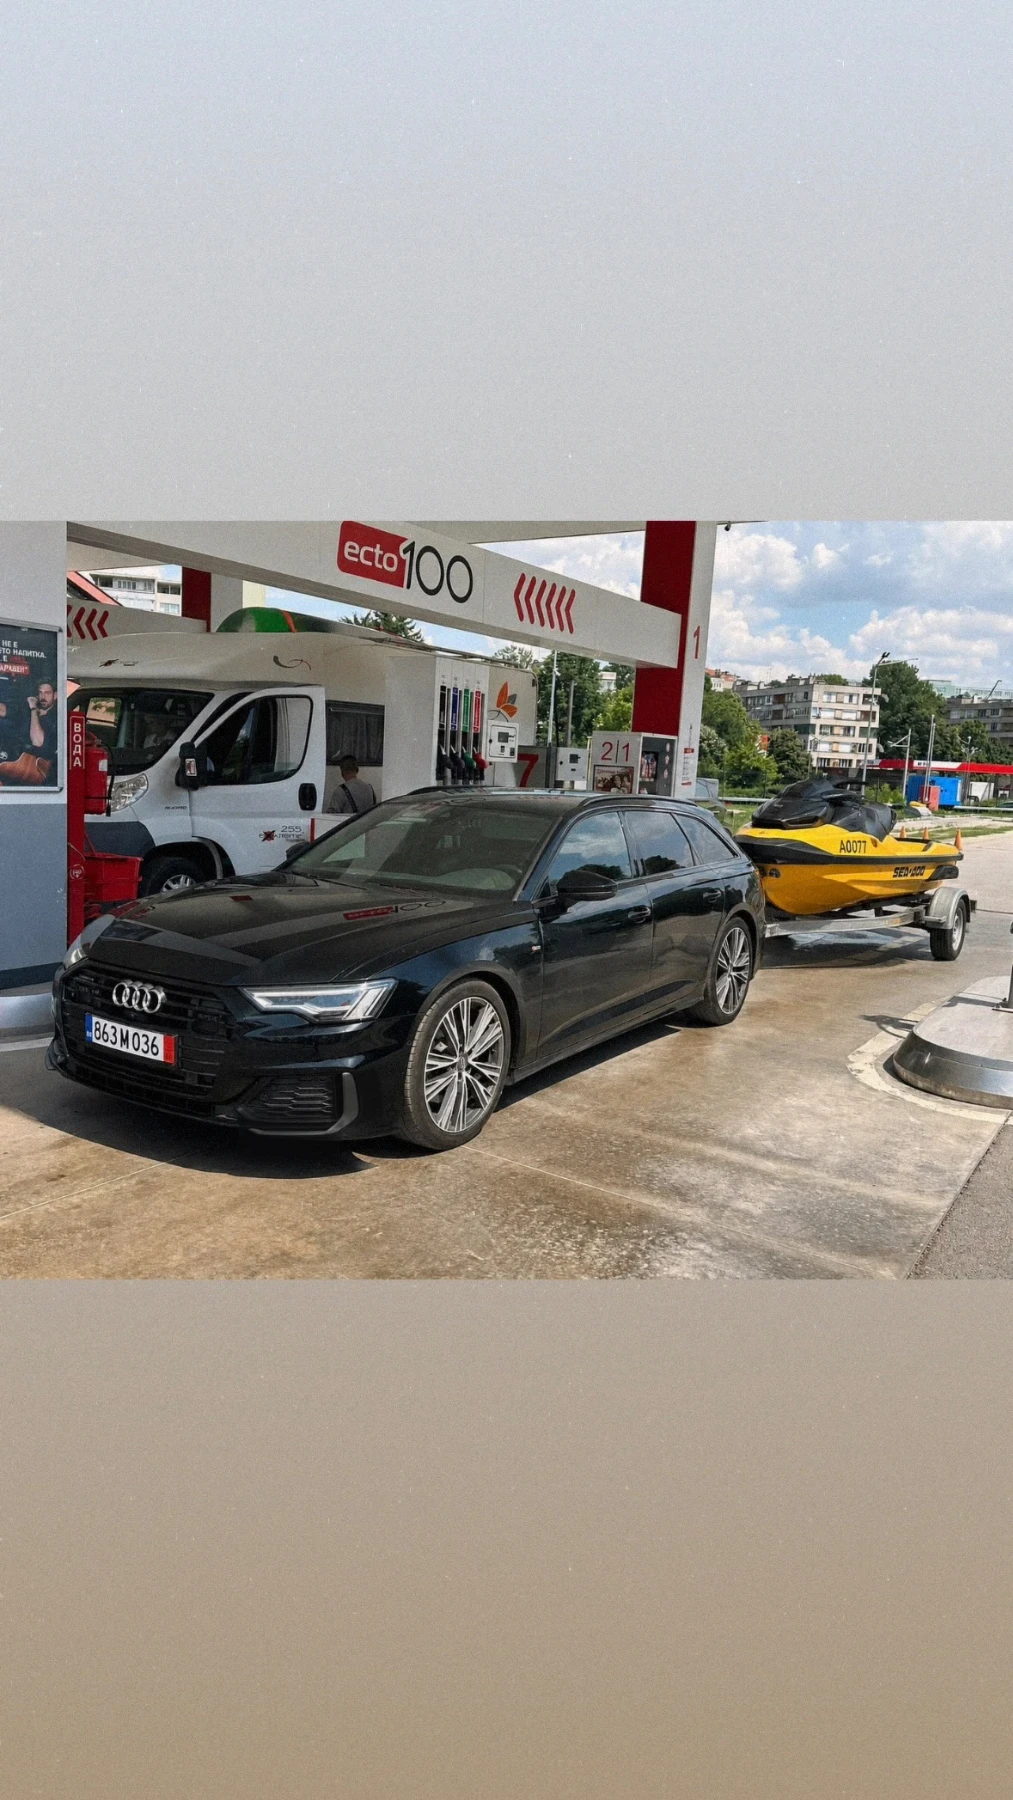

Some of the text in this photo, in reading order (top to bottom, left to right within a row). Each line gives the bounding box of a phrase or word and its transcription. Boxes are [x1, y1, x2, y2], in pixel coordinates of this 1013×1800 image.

[693, 625, 701, 659] 1
[73, 723, 82, 767] ВОДА
[839, 839, 867, 853] A0077
